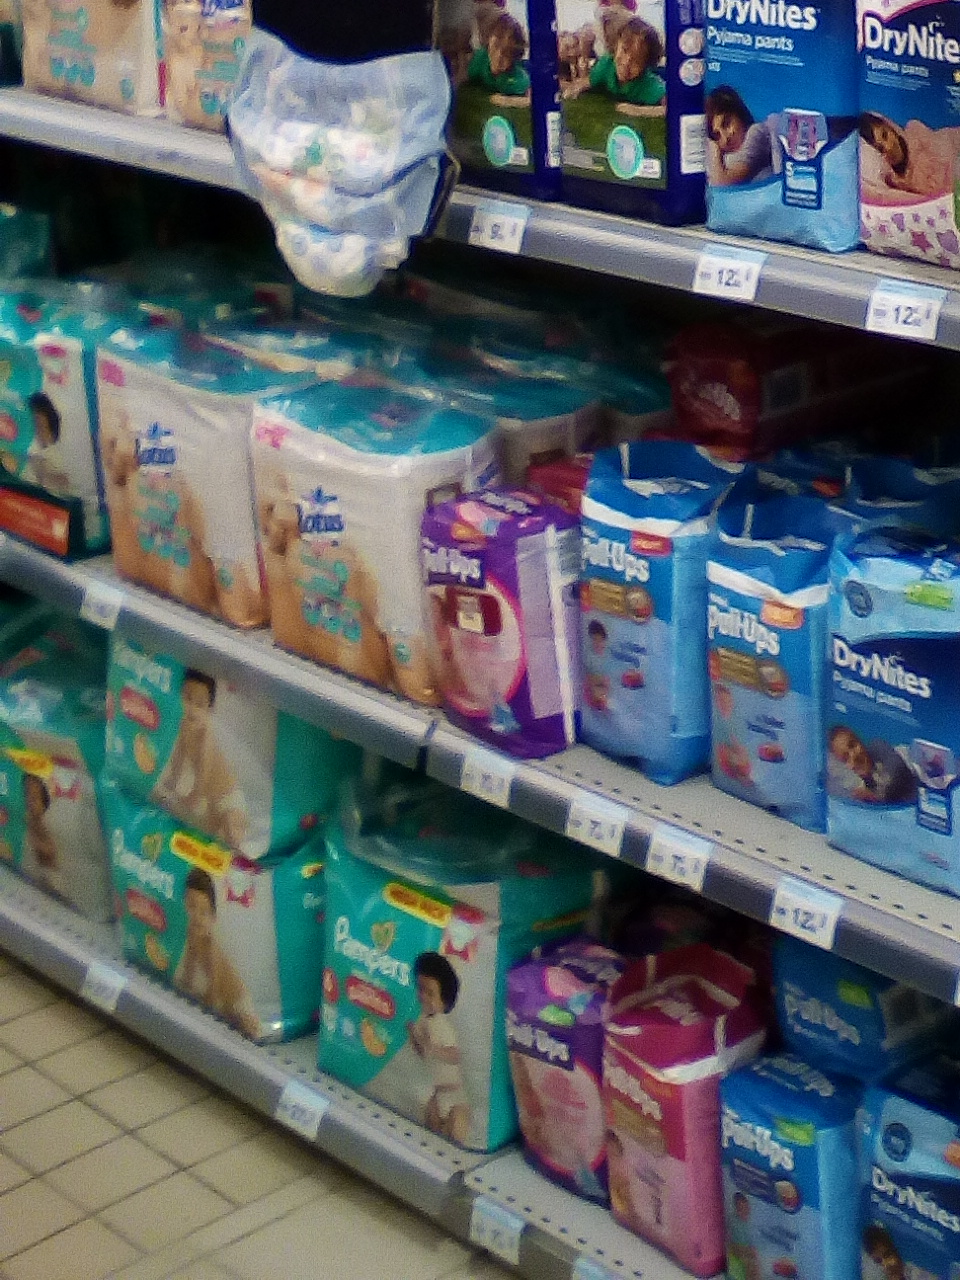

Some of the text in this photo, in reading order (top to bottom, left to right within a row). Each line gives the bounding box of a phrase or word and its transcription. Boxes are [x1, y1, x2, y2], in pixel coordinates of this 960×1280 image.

[707, 27, 795, 52] Pyjama pants
[833, 639, 932, 699] DryNites
